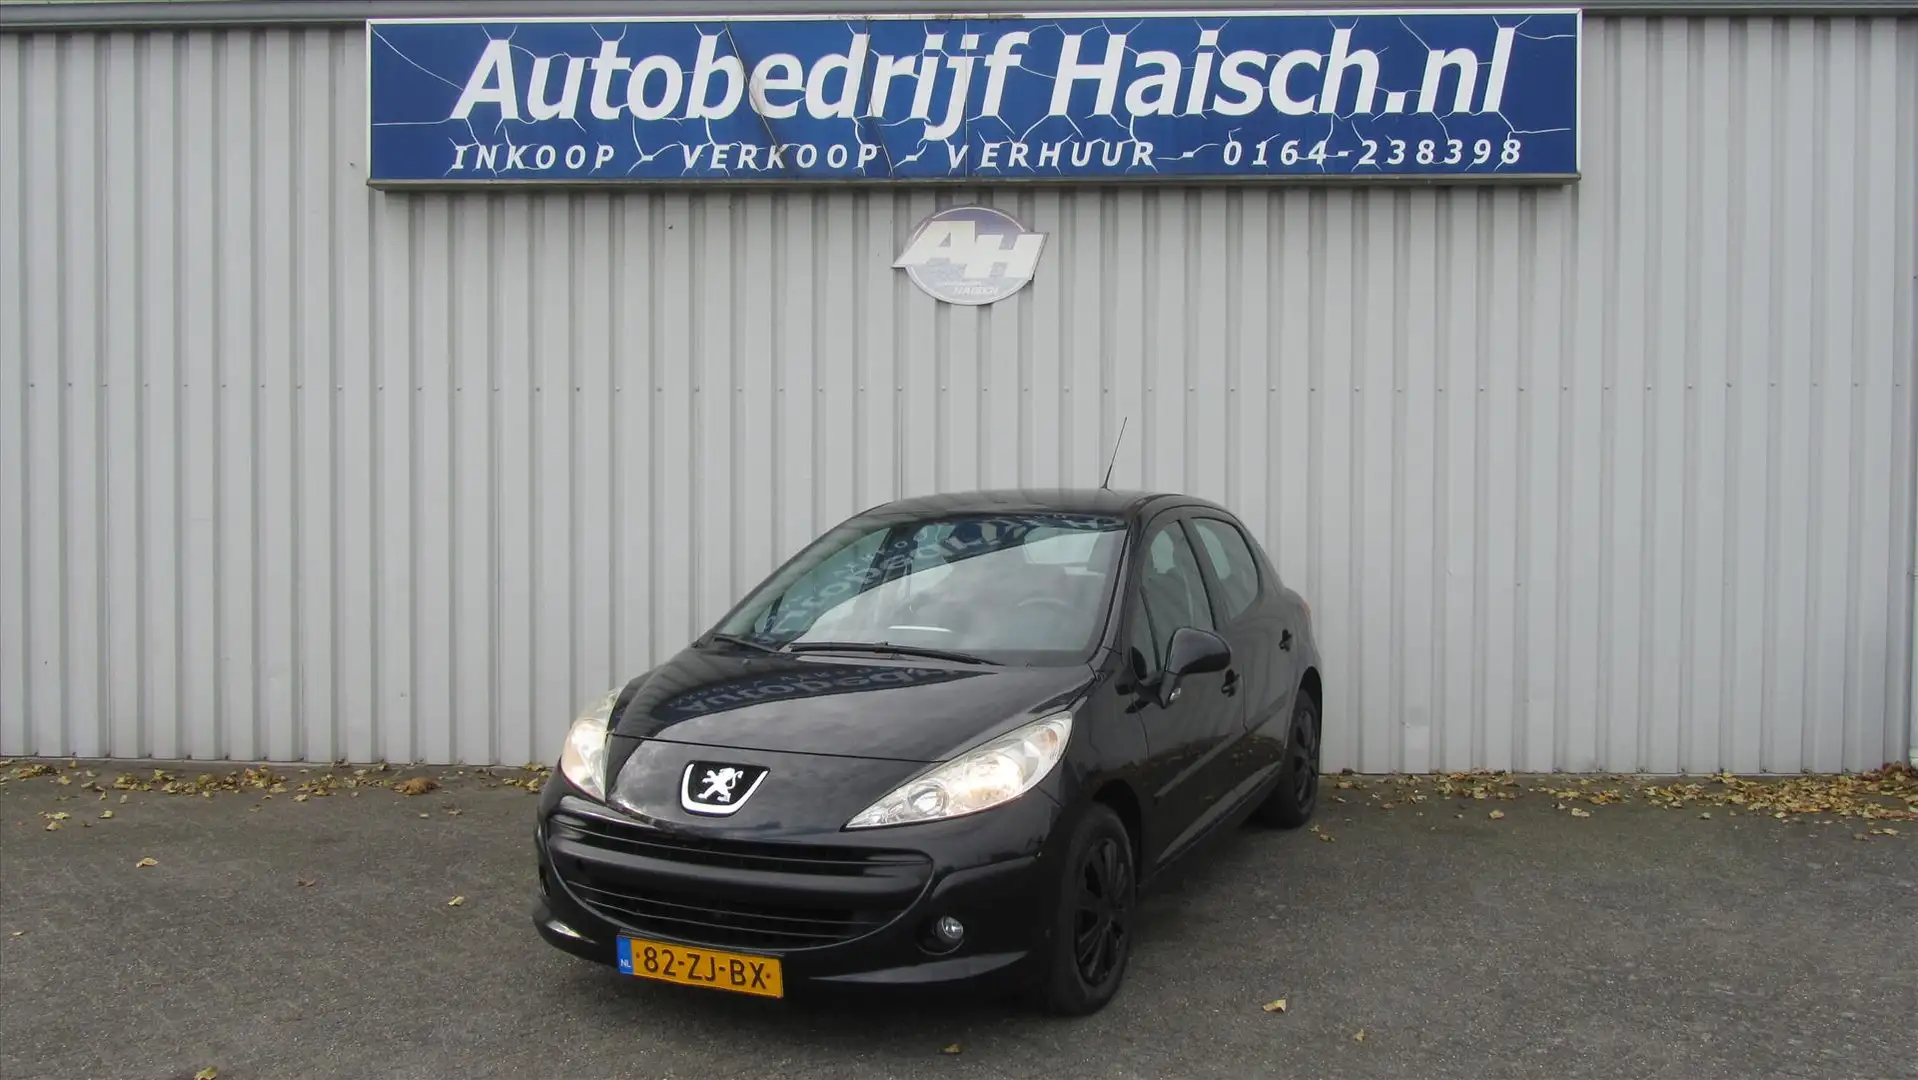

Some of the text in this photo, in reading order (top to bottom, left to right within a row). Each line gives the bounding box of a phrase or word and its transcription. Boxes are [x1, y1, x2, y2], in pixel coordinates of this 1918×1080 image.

[450, 26, 1516, 140] Autobedrijf Haisch.nl
[451, 145, 615, 169] INKOOP
[682, 143, 878, 169] VERKOOP
[948, 141, 1154, 169] VERHUUR
[1222, 139, 1522, 166] 0164-238398
[893, 220, 1045, 279] AH
[620, 959, 632, 968] NL
[643, 946, 767, 990] 82-ZJ-BX
